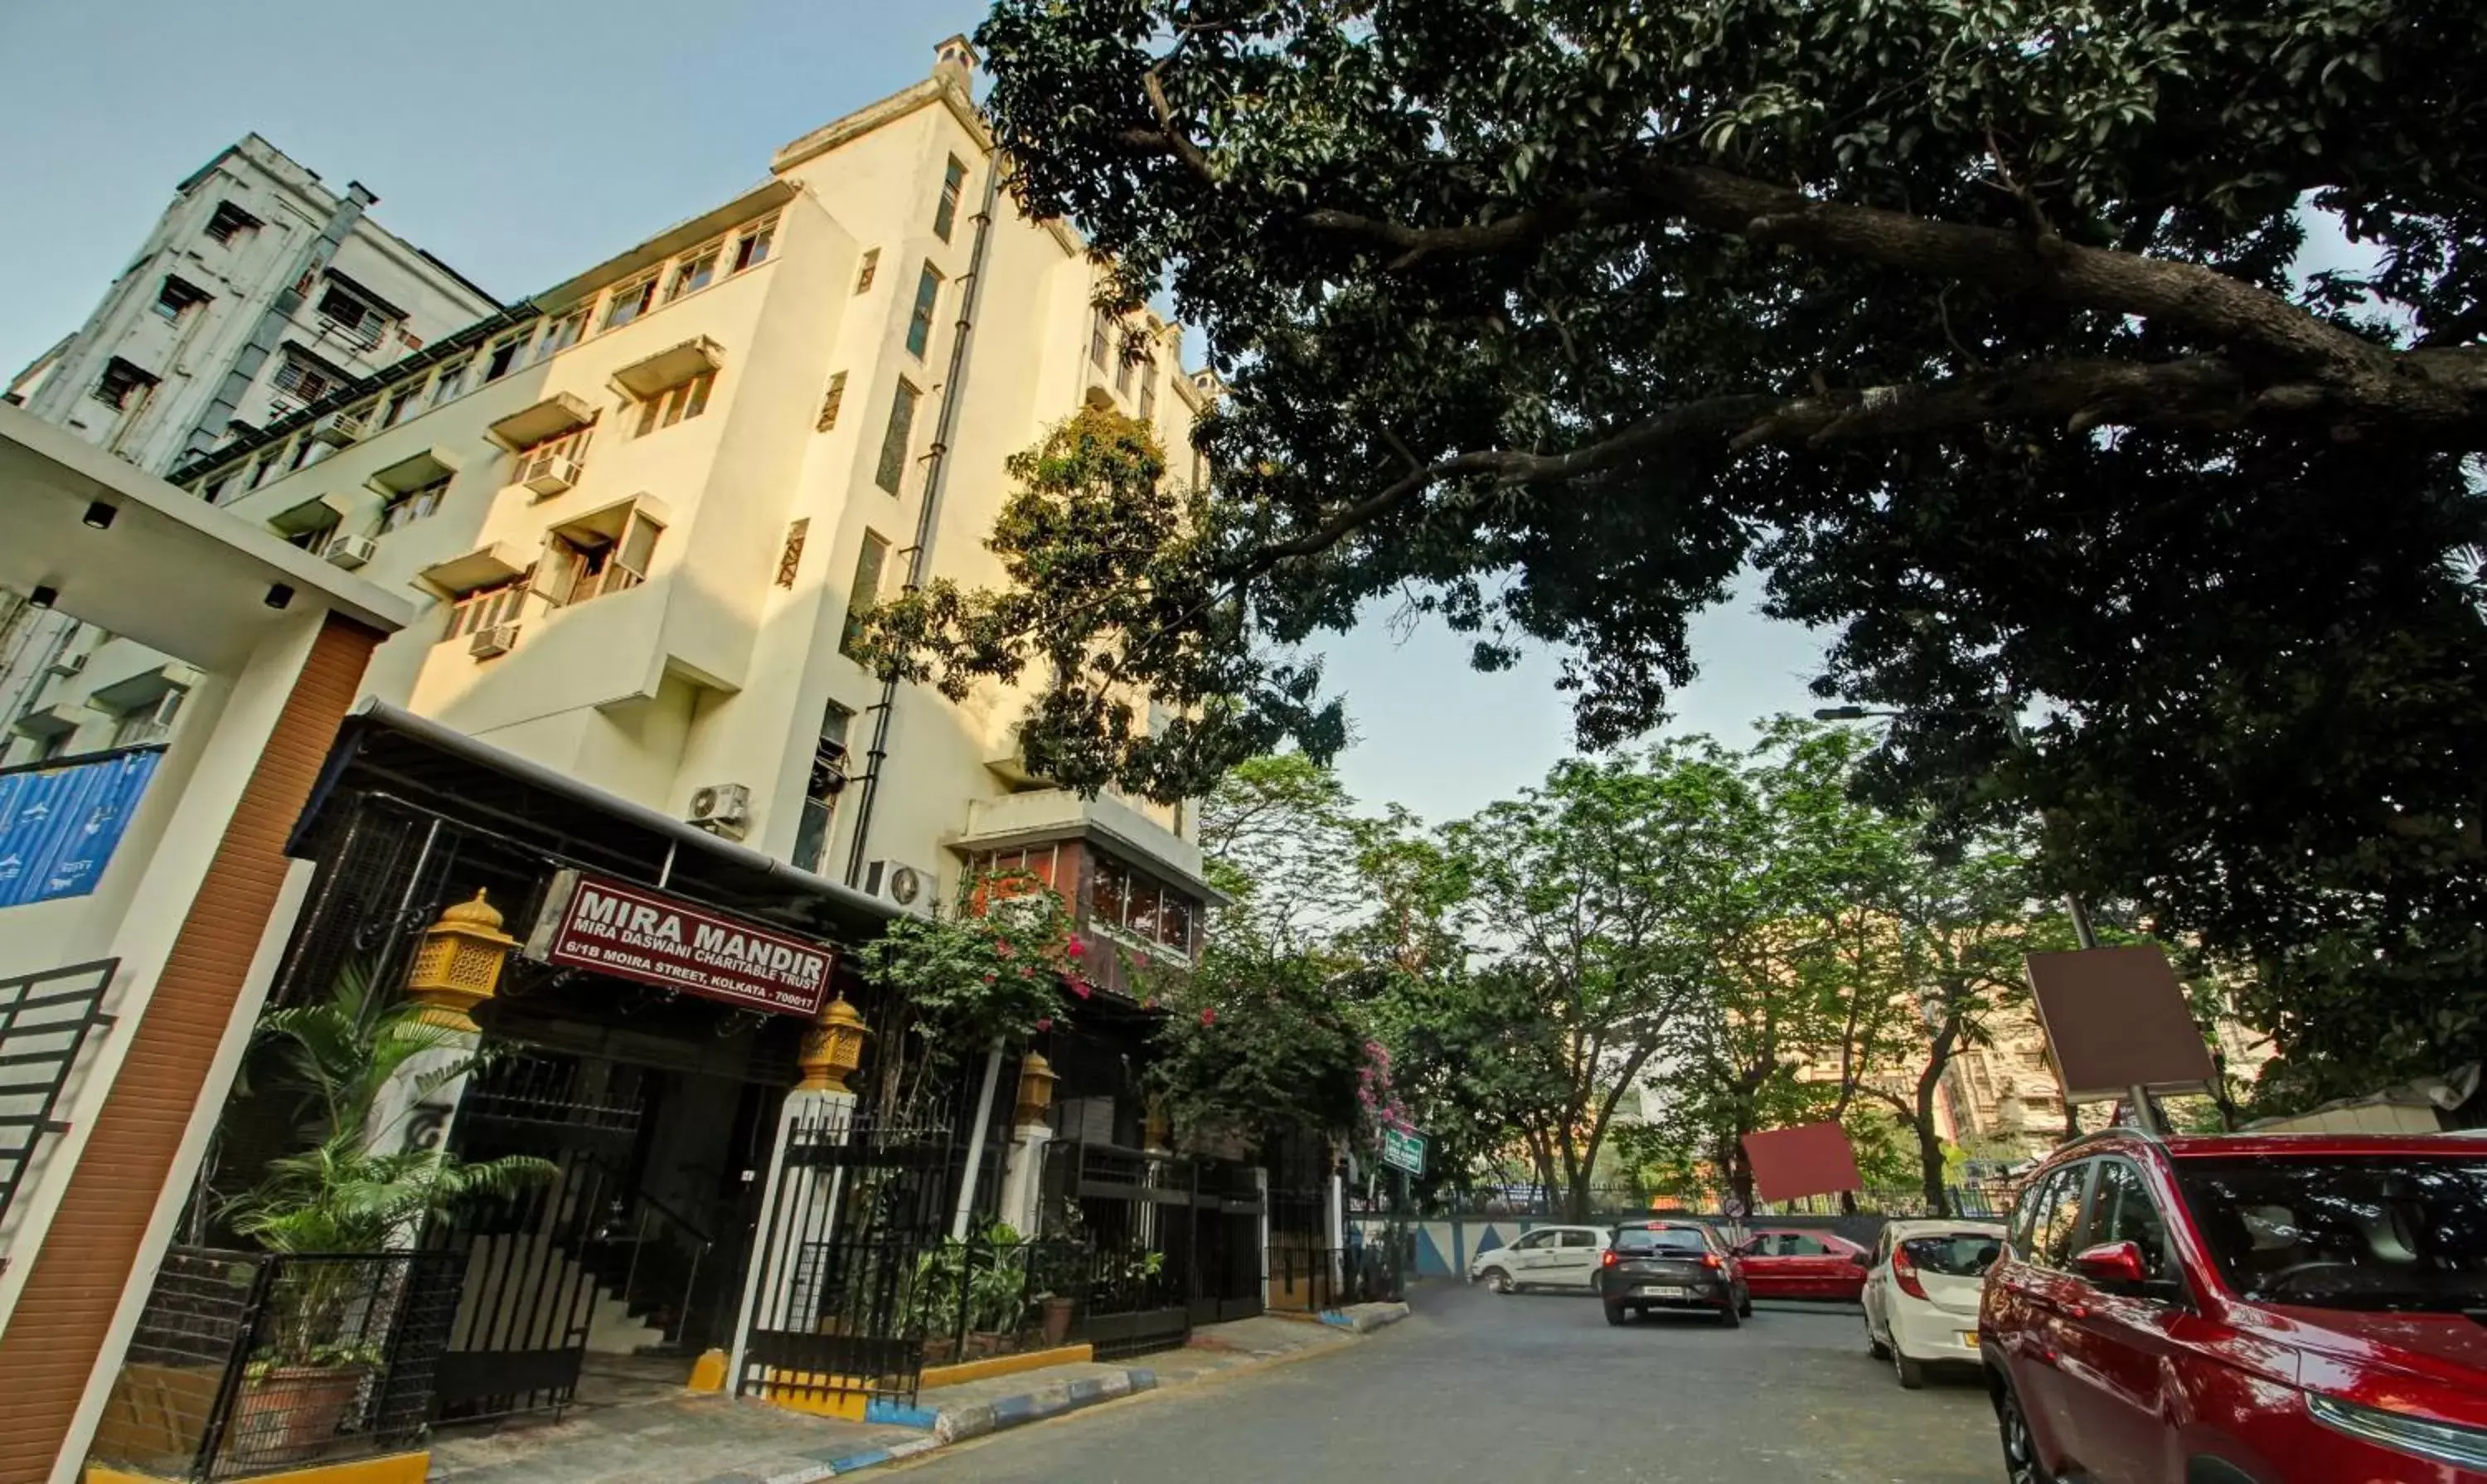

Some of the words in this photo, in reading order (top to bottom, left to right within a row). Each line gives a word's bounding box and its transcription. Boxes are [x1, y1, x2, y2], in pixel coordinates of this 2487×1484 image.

[565, 941, 601, 958] 6/1B
[604, 949, 652, 970] MOIRA
[655, 961, 708, 985] STREET,
[710, 976, 766, 997] KOLKATA
[573, 918, 617, 940] MIRA
[621, 929, 691, 958] DASWANI
[695, 949, 778, 981] CHARITABLE
[780, 971, 820, 992] TRUST
[578, 891, 681, 943] MIRA
[693, 924, 824, 981] MANDIR
